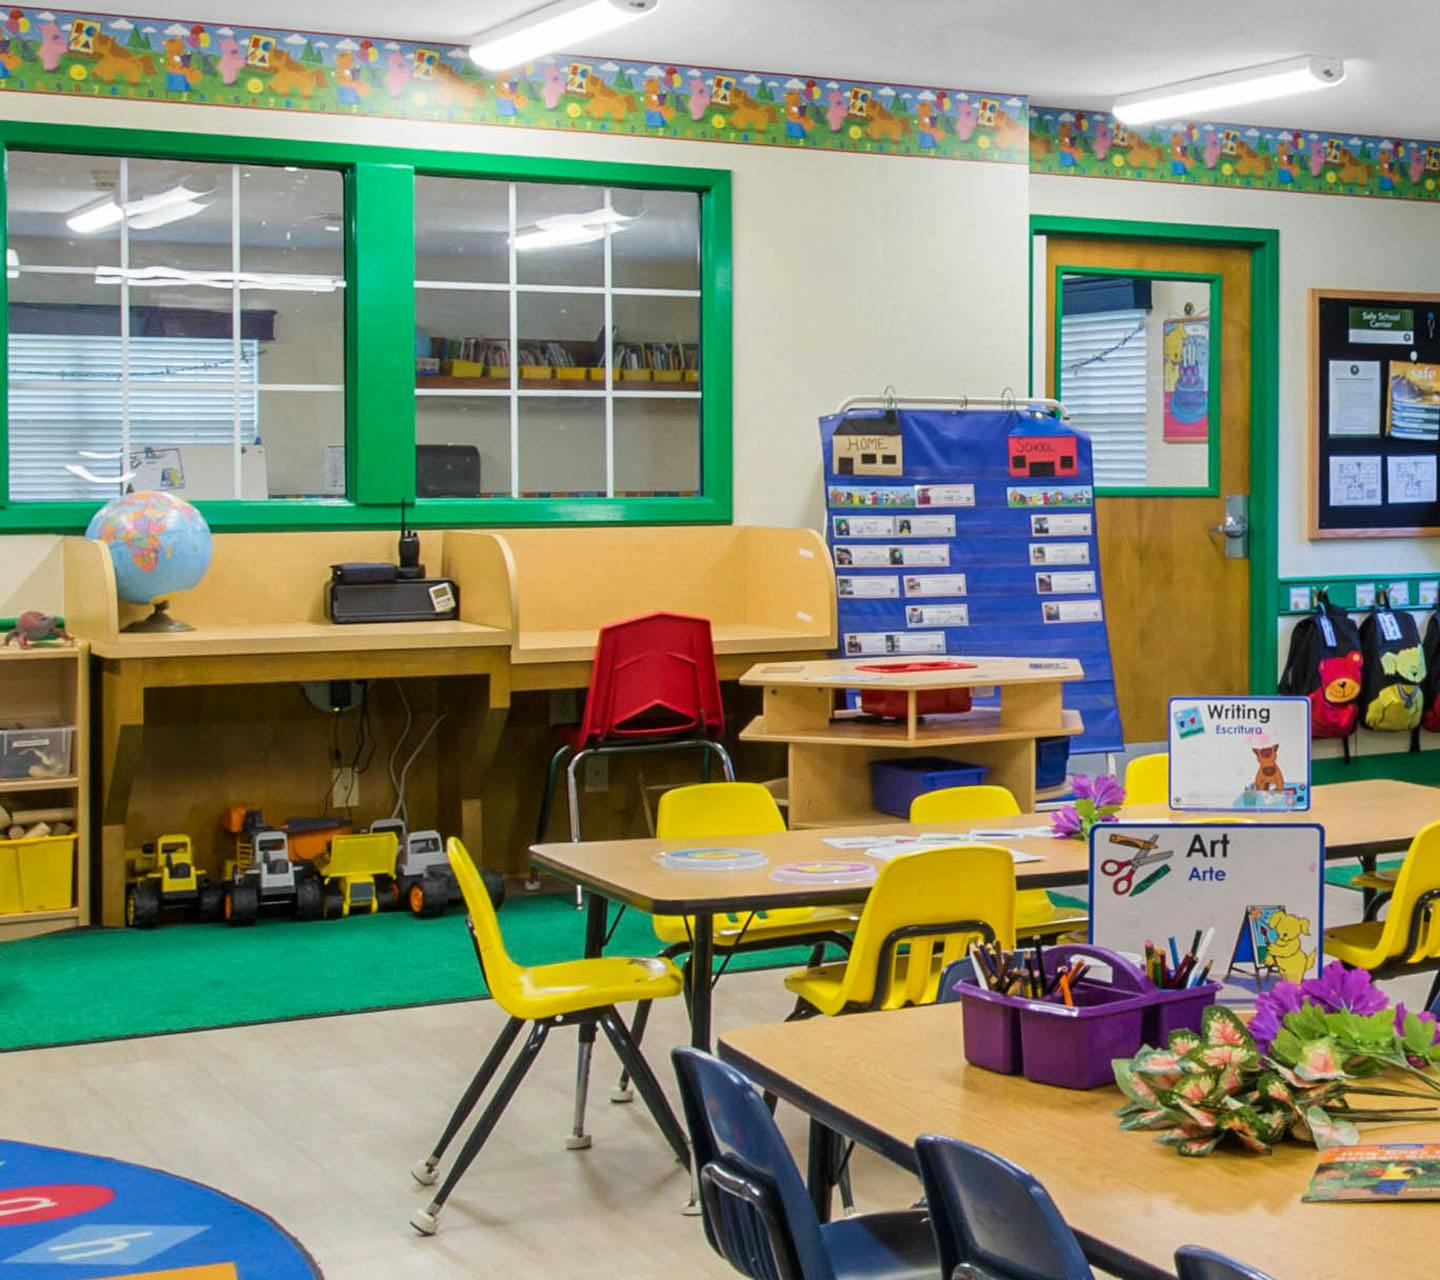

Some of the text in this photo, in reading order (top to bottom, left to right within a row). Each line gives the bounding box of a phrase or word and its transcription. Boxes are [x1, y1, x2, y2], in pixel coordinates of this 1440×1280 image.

[1361, 310, 1402, 322] Safe School
[1369, 319, 1393, 329] Center
[845, 437, 888, 452] HOME
[1207, 704, 1271, 724] Writing
[1215, 724, 1263, 735] Escritura
[1186, 833, 1230, 858] Art
[1188, 866, 1226, 882] Arte
[48, 1230, 153, 1262] h
